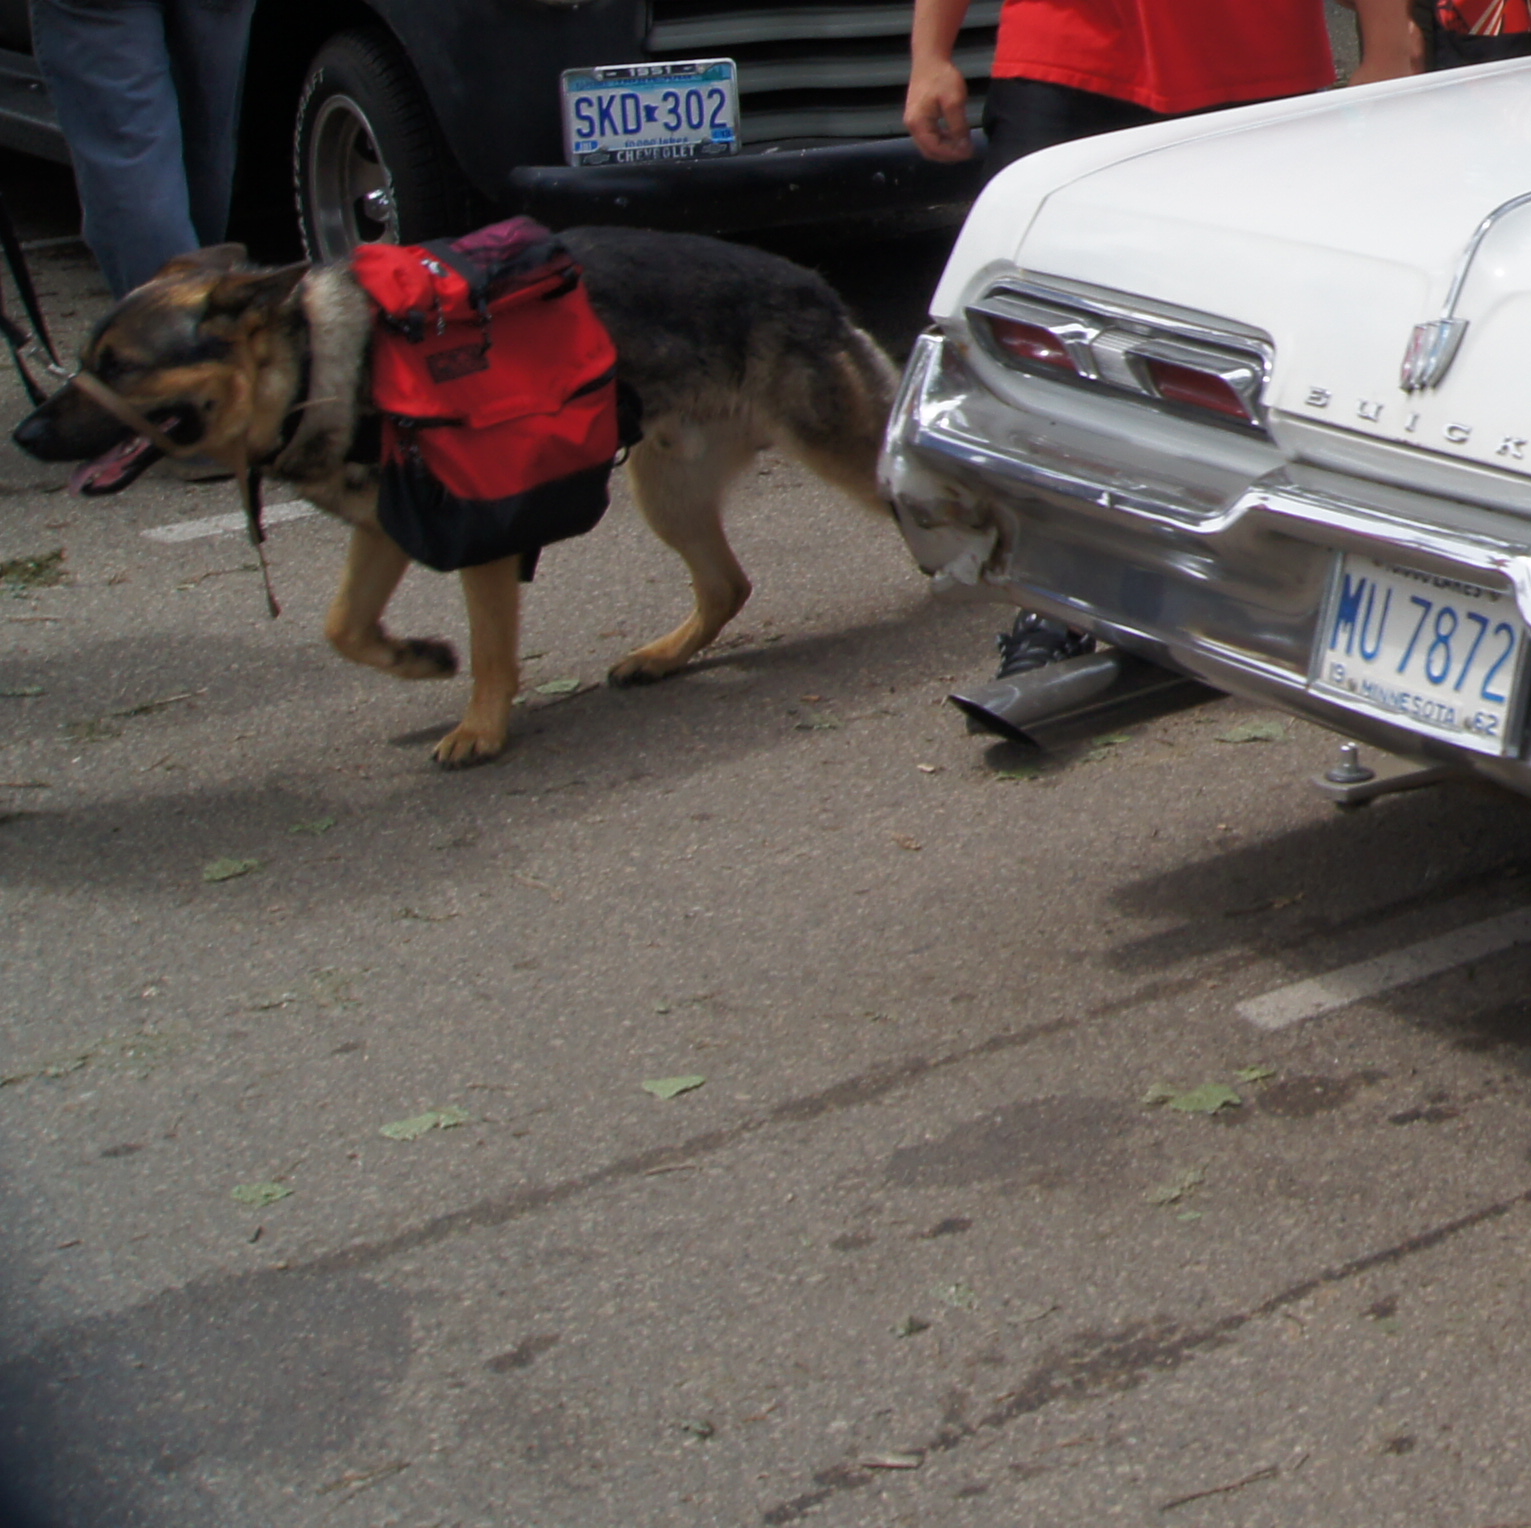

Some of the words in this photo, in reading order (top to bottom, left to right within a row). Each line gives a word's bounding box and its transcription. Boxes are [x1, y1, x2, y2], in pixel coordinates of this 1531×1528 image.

[630, 65, 672, 77] 1951
[574, 92, 642, 139] SKD
[662, 88, 728, 133] 302
[616, 144, 696, 163] CHEVROLET
[1305, 386, 1528, 460] BUICK
[1330, 573, 1393, 661] MU
[1396, 594, 1516, 704] 7872
[1361, 678, 1457, 725] MINNESOTA
[1473, 710, 1499, 736] 62
